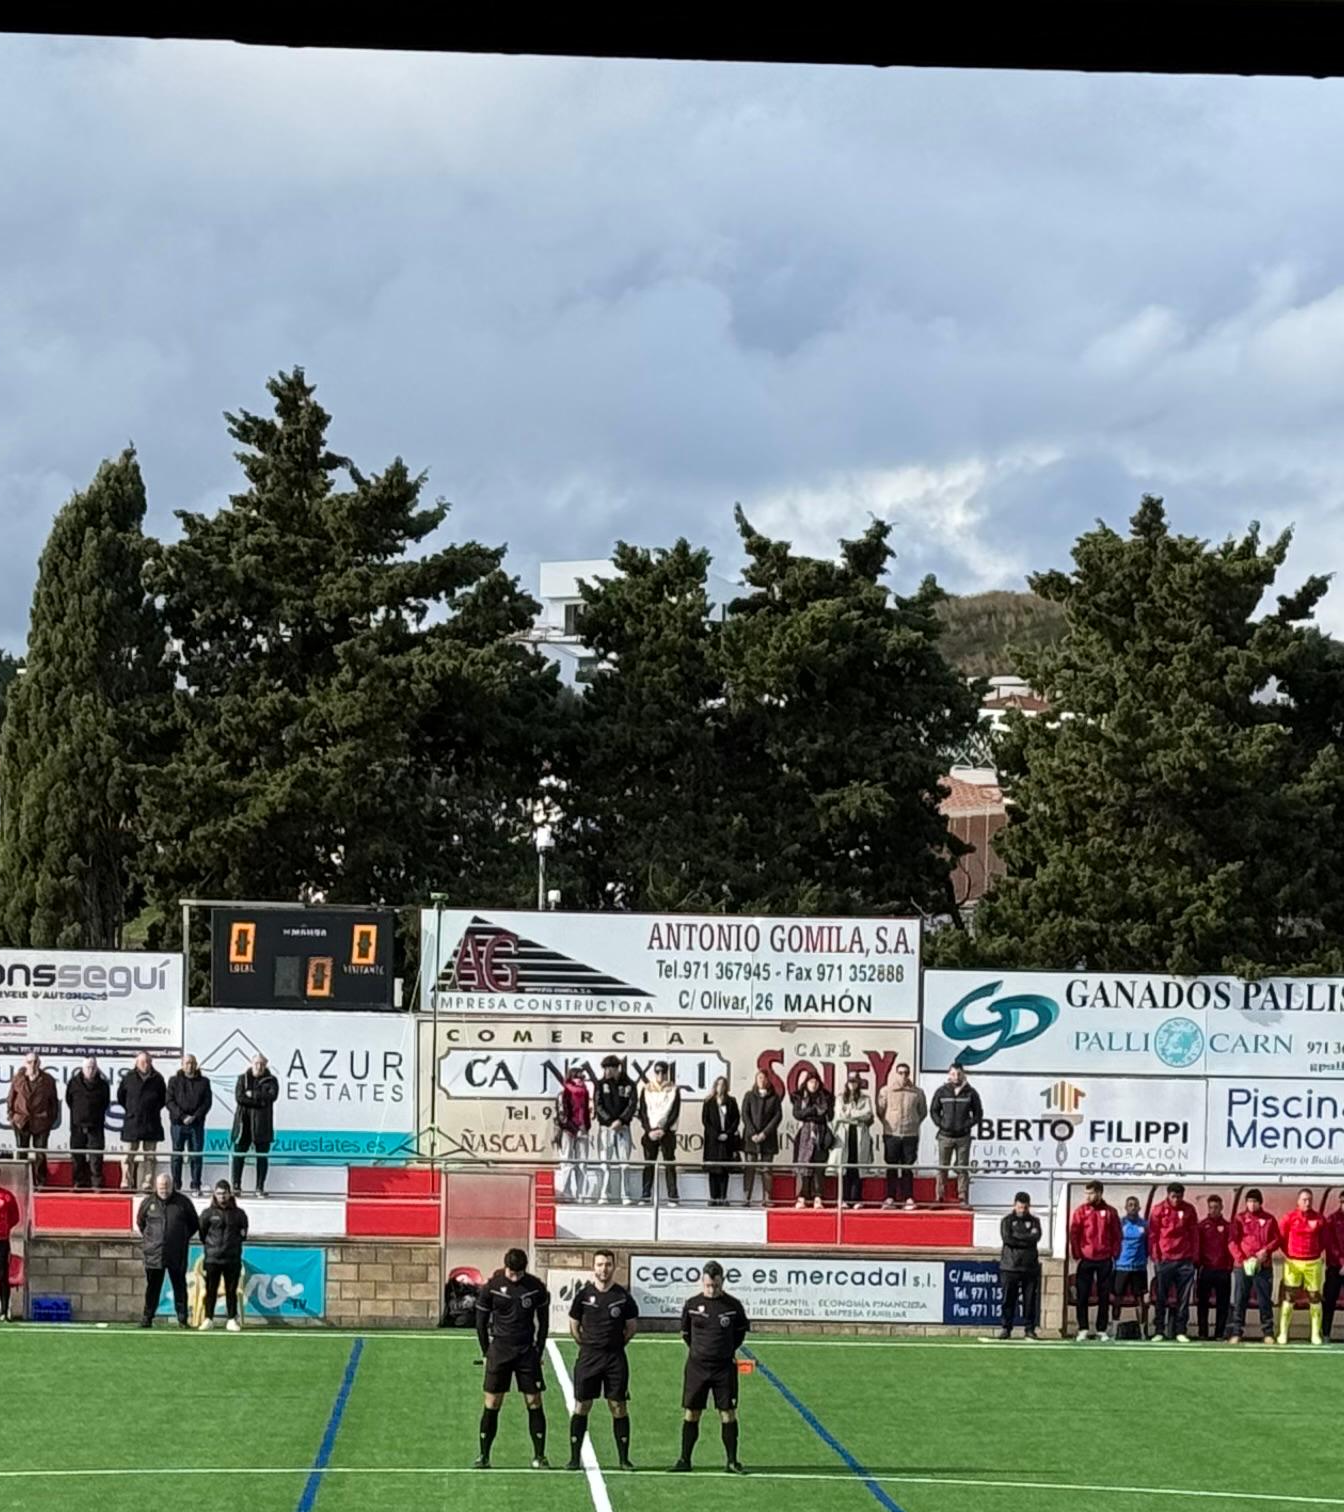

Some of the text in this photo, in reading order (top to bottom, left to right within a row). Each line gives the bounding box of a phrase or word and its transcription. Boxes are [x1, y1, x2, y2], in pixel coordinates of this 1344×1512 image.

[229, 922, 256, 963] 0
[351, 924, 377, 964] 0
[647, 923, 915, 957] ANTONIO GOMILA, S.A.
[229, 964, 256, 973] LOCAL
[307, 956, 333, 996] 0
[343, 964, 385, 975] VISITANTE
[715, 962, 771, 981] 367945
[786, 963, 812, 982] Fax
[817, 964, 843, 982] 971
[849, 965, 904, 983] 352888
[679, 988, 873, 1013] C/ Olivar, 26 MAHÓN
[1066, 979, 1231, 1010] GANADOS
[514, 998, 655, 1013] CONSTRUCTORA
[447, 1029, 714, 1045] COMERCIAL
[1209, 1033, 1293, 1054] CARN
[1307, 1041, 1329, 1054] 971
[796, 1040, 851, 1057] CAFÉ
[287, 1049, 404, 1081] AZUR
[465, 1056, 518, 1091] CA
[287, 1082, 404, 1102] ESTATES
[507, 1106, 536, 1120] Tel.
[971, 1119, 1189, 1144] BERTO FILIPPI
[1079, 1145, 1190, 1161] DECORACIÓN
[637, 1266, 937, 1288] cecoe es mercadal s.l.
[954, 1287, 969, 1300] Tel.
[971, 1287, 987, 1300] 971
[953, 1304, 969, 1317] Fax
[970, 1304, 987, 1317] 971
